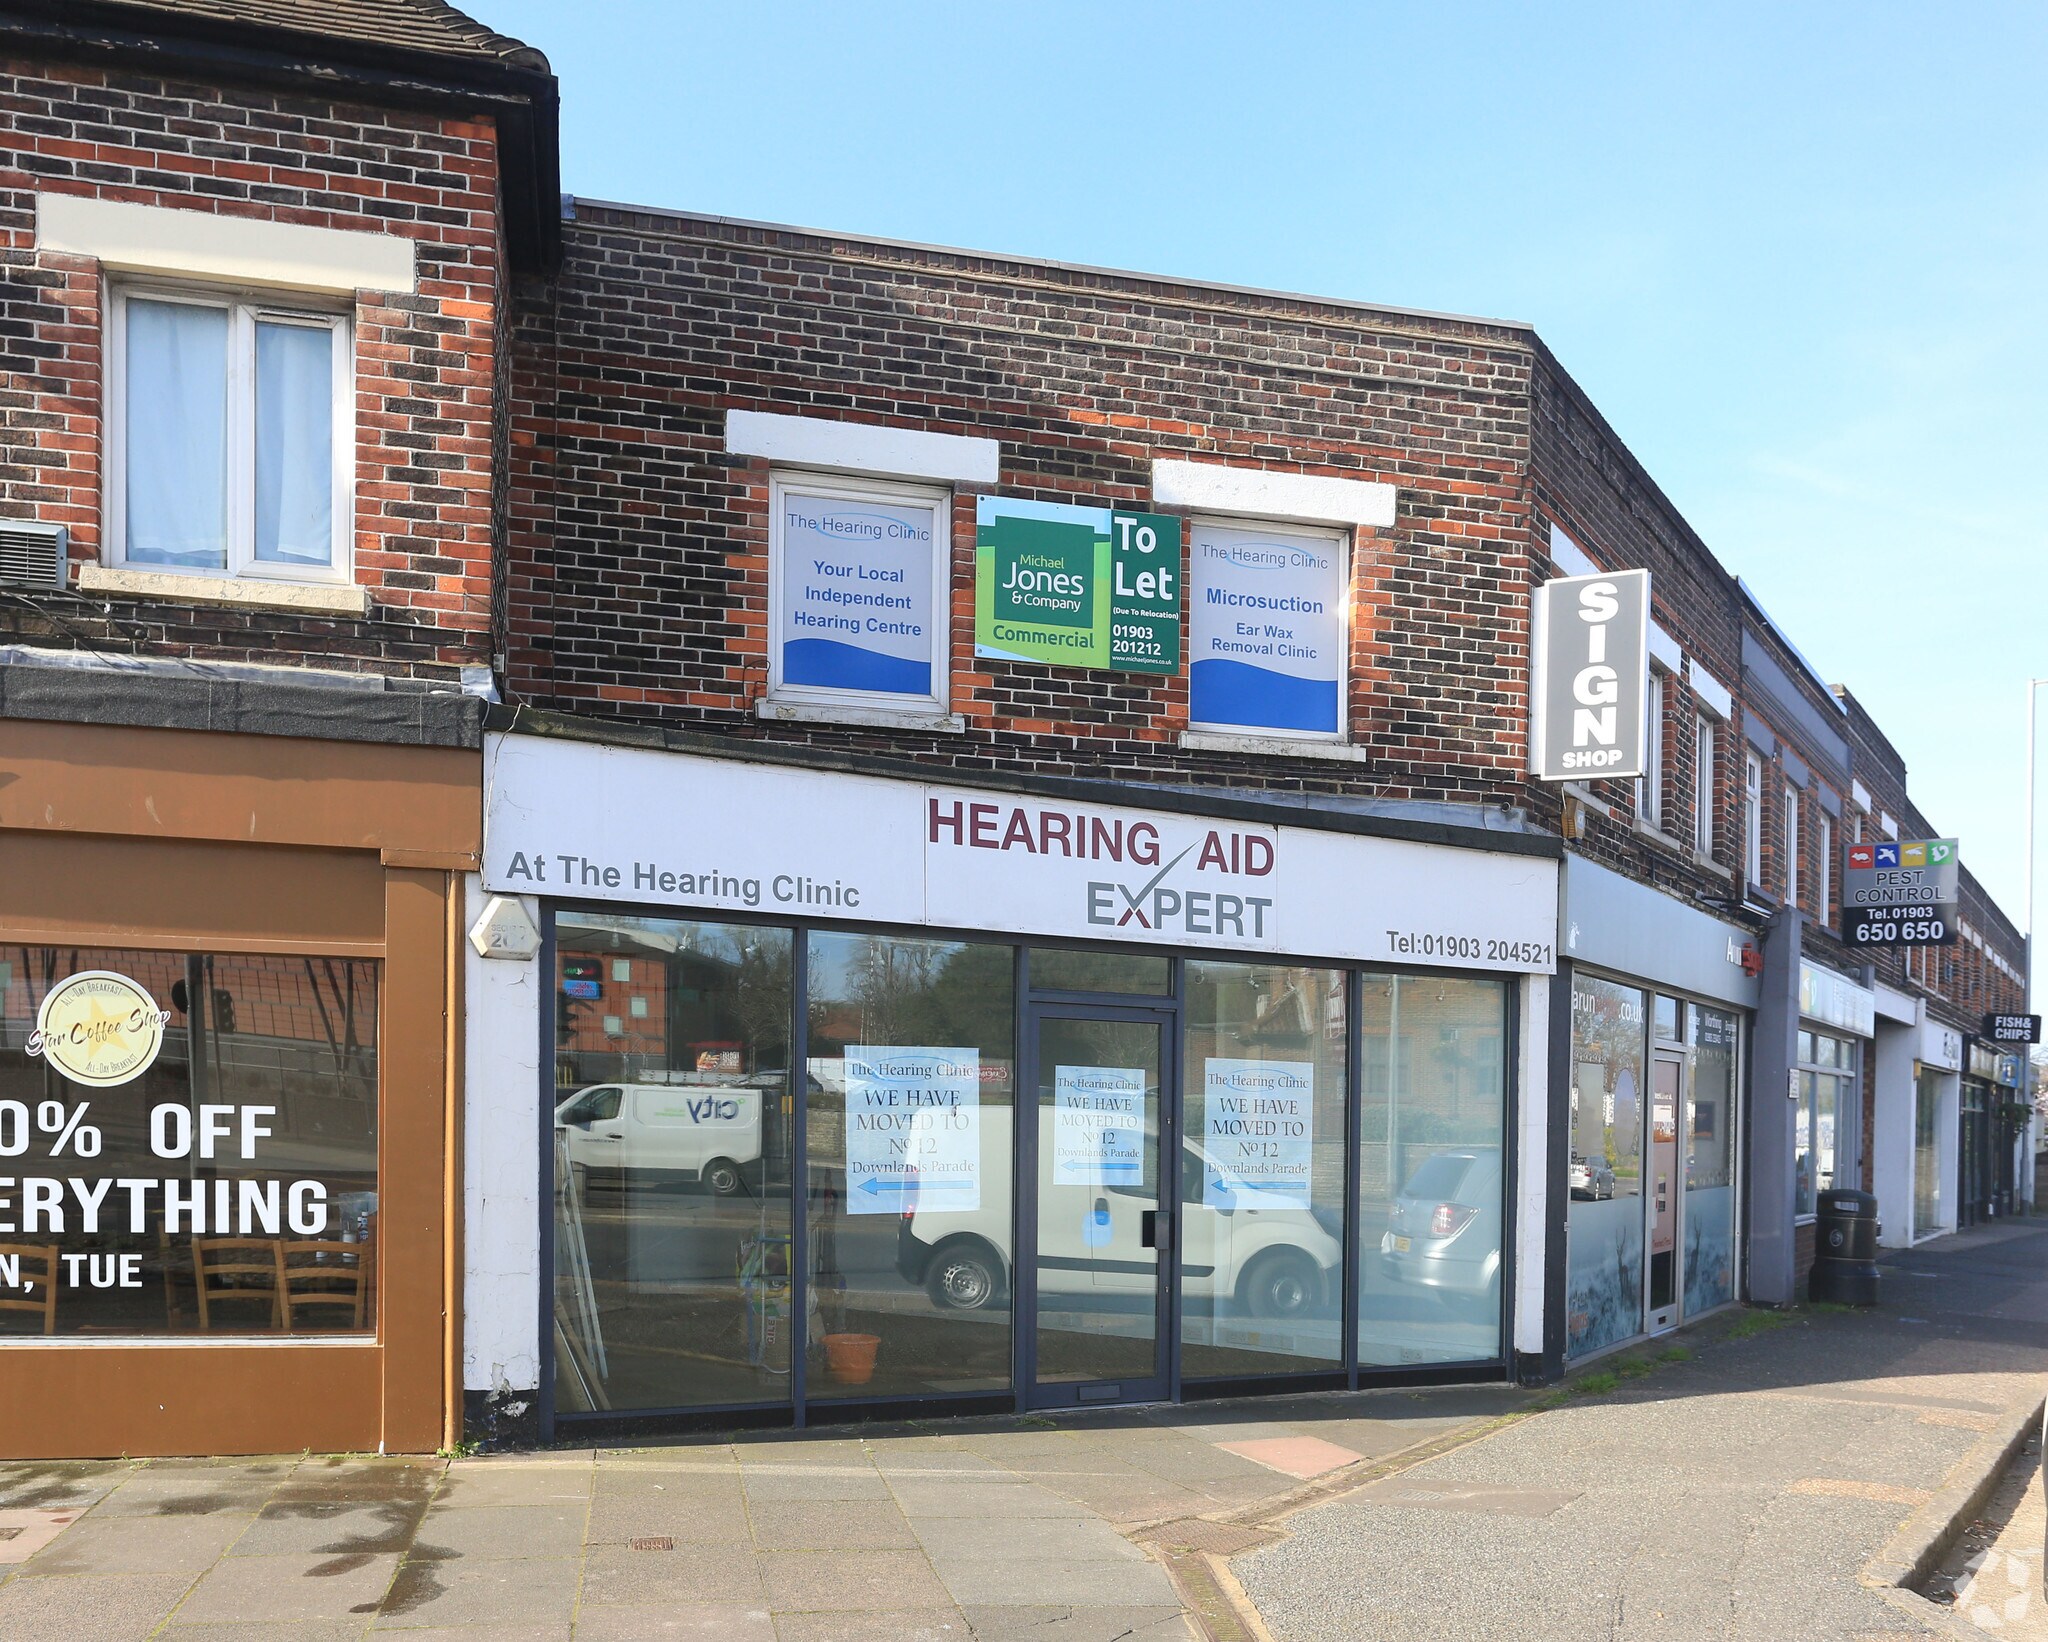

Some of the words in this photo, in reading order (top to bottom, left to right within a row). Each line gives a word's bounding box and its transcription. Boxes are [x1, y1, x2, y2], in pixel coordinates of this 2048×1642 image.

[788, 513, 817, 529] The
[822, 517, 882, 539] Hearing
[888, 525, 930, 541] Clinic
[1114, 516, 1157, 554] To
[1019, 554, 1065, 570] Michael
[1201, 544, 1227, 559] The
[1232, 547, 1286, 568] Hearing
[1290, 553, 1328, 569] Clinic
[814, 560, 853, 577] Your
[858, 565, 904, 582] Local
[1002, 562, 1084, 596] Jones
[1115, 562, 1173, 600] Let
[805, 586, 912, 609] Independent
[1012, 591, 1022, 604] &
[1024, 594, 1081, 613] Company
[1206, 588, 1323, 614] Microsuction
[1113, 607, 1130, 616] (Due
[1130, 608, 1140, 616] To
[1140, 608, 1179, 620] Relocation)
[794, 611, 861, 634] Hearing
[866, 618, 922, 636] Centre
[1113, 624, 1153, 640] 01903
[1236, 622, 1260, 636] Ear
[1264, 625, 1293, 639] Wax
[993, 625, 1095, 649] Commercial
[1113, 640, 1162, 656] 201212
[1212, 638, 1273, 655] Removal
[1278, 643, 1317, 659] Clinic
[1112, 655, 1172, 666] www.michaeljones.co.uk
[1572, 581, 1619, 748] SIGN
[1562, 749, 1623, 769] SHOP
[930, 797, 1161, 867] HEARING
[1196, 829, 1275, 877] AID
[506, 851, 546, 881] At
[557, 855, 621, 888] The
[633, 861, 761, 906] Hearing
[772, 874, 861, 908] Clinic
[1876, 871, 1924, 886] PEST
[1855, 886, 1946, 903] CONTROL
[1086, 881, 1273, 939] EXPERT
[1892, 906, 1934, 919] 01903
[1856, 922, 1897, 941] 650
[1902, 921, 1944, 940] 650
[1386, 929, 1481, 960] Tel:01903
[1488, 939, 1552, 966] 204521
[87, 981, 123, 996] BREAKFAST
[25, 1029, 66, 1056] Star
[70, 1020, 123, 1045] Coffee
[126, 1007, 171, 1033] Shop
[1995, 1028, 2032, 1041] CHIPS
[111, 1053, 138, 1074] BREAKFAST
[849, 1063, 874, 1076] The
[879, 1063, 932, 1079] Hearing
[936, 1064, 974, 1077] Clinic
[1057, 1077, 1075, 1087] The
[1077, 1078, 1113, 1091] Hearing
[1115, 1080, 1141, 1090] Clinic
[1208, 1074, 1228, 1085] The
[1232, 1075, 1275, 1091] Hearing
[1278, 1076, 1309, 1089] Clinic
[864, 1089, 898, 1106] WE
[907, 1090, 962, 1107] HAVE
[1067, 1096, 1090, 1109] WE
[1095, 1098, 1133, 1111] HAVE
[1220, 1097, 1248, 1113] WE
[1254, 1099, 1299, 1115] HAVE
[856, 1113, 934, 1131] MOVED
[942, 1113, 970, 1131] TO
[1061, 1114, 1113, 1128] MOVED
[1119, 1115, 1138, 1129] TO
[1212, 1119, 1276, 1136] MOVED
[1281, 1121, 1304, 1137] TO
[150, 1103, 276, 1159] OFF
[1101, 1132, 1116, 1145] 12
[1058, 1147, 1108, 1158] Downlands
[1110, 1149, 1140, 1158] Parade
[1261, 1142, 1279, 1158] 12
[853, 1161, 927, 1174] Downlands
[931, 1160, 975, 1173] Parade
[1208, 1162, 1269, 1174] Downlands
[1272, 1162, 1308, 1174] Parade
[61, 1254, 143, 1288] TUE
